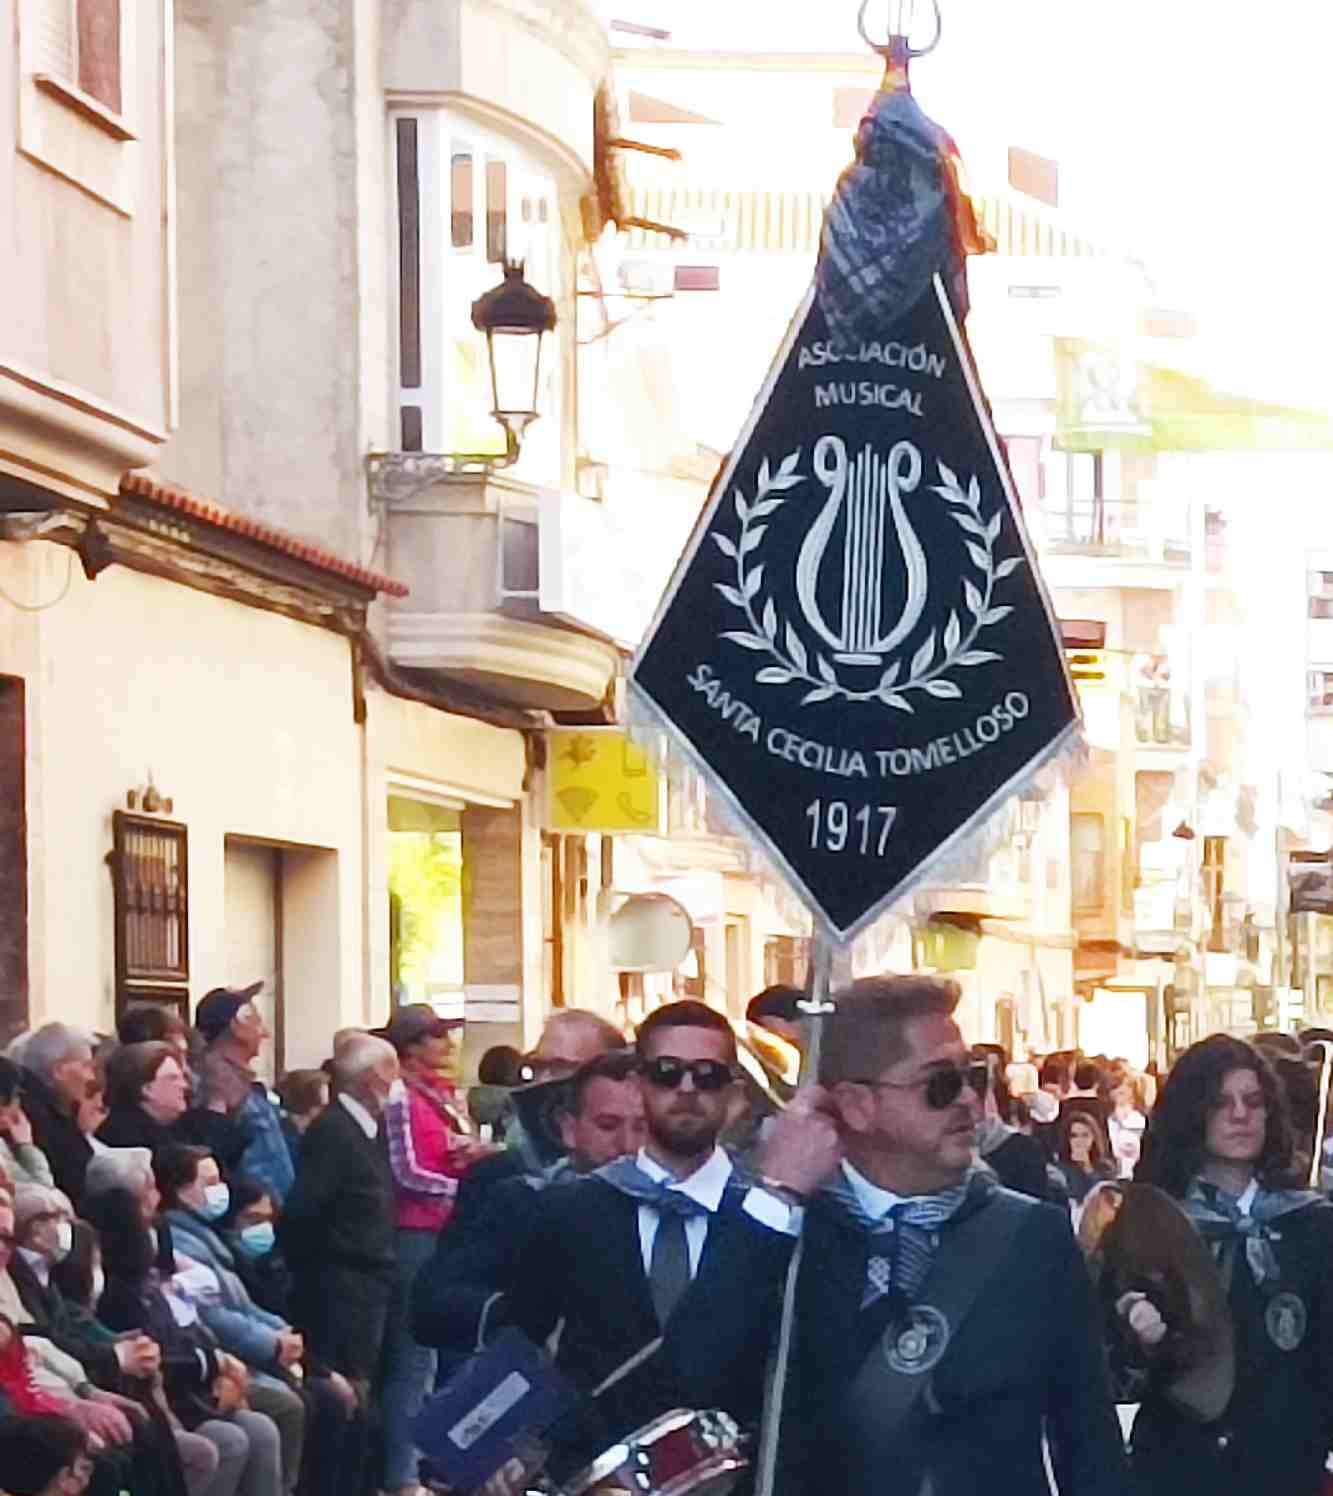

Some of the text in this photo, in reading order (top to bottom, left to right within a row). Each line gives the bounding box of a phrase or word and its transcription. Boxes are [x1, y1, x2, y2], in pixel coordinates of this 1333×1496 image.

[799, 340, 946, 379] ASOIACIÓN
[814, 380, 924, 417] MUSICAL
[686, 663, 1029, 778] SANTA CECILIA TOMELLOSO
[805, 799, 897, 857] 1917
